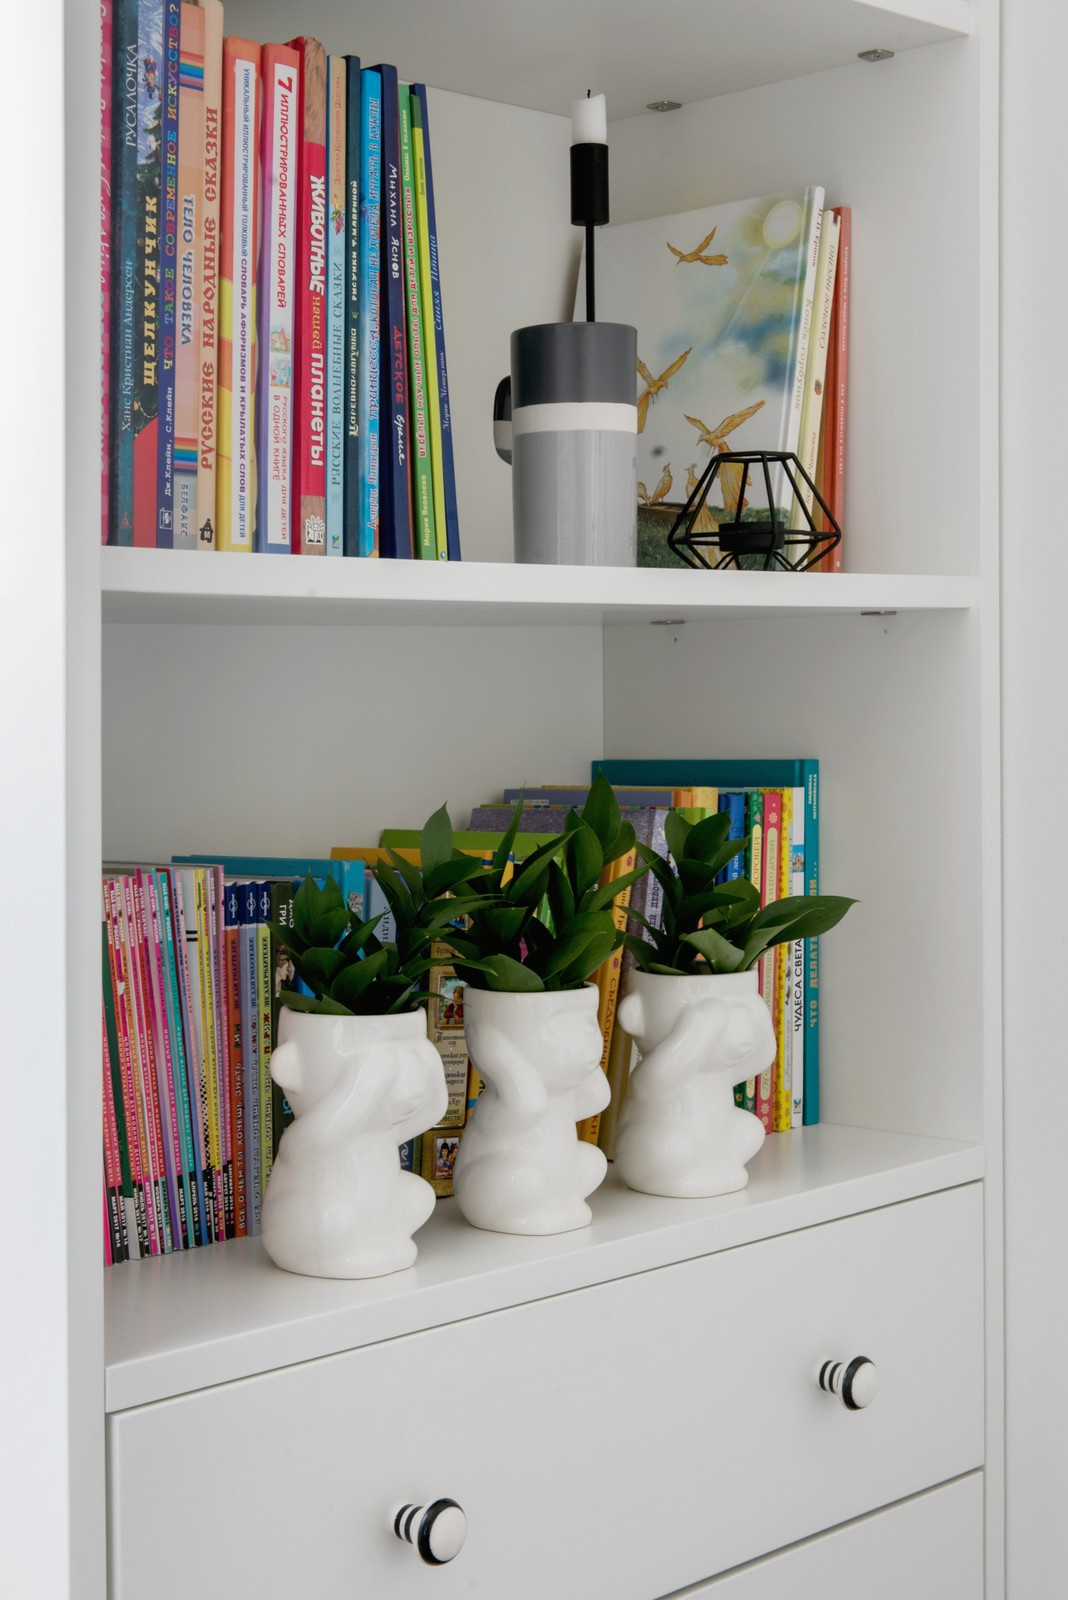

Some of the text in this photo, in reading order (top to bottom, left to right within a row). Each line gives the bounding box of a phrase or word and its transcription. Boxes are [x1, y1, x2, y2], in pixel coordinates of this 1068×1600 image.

[125, 44, 138, 147] РУСАЛОЧКА
[243, 68, 251, 123] УНИКАЛЬНЫЙ
[204, 106, 218, 202] СКАЗКИ
[241, 124, 250, 212] ИЛЛЮСТРИРОВАННЫЙ
[163, 4, 179, 370] ЧТО ТАКОЕ СОВРЕМЕННОЕ ИСКУССТВО?
[277, 76, 293, 308] 7 ИЛЛЮСТРИРОВАННЫХ СЛОВАРЕЙ
[241, 213, 249, 257] ТОЛКОВЫЙ
[309, 174, 326, 296] ЖИВОТНЫЕ
[143, 195, 157, 386] ЩЕЛКУНЧИК
[181, 196, 195, 345] ТЕЛО ЧЕЛОВЕКА
[240, 258, 248, 309] СЛОВАРЬ
[406, 258, 419, 291] ДЕТЕЙ
[409, 294, 420, 314] ДЛЯ
[122, 329, 134, 395] Кристиан
[240, 312, 248, 382] АФОРИЗМОВ
[393, 325, 404, 404] ДЕТСКОЕ
[411, 317, 421, 357] ОПЫТЫ
[331, 262, 343, 485] РУССКИЕ ВОЛШЕБНЫЕ СКАЗКИ
[121, 398, 132, 431] Ханс
[239, 396, 247, 460] КРЫЛАТЫХ
[273, 405, 281, 443] ОДНОЙ
[273, 448, 281, 480] КНИГЕ
[239, 513, 247, 538] ДЕТЕЙ
[794, 938, 803, 1032] ЧУДЕСА СВЕТА
[233, 1024, 241, 1049] РИМ
[263, 1012, 271, 1054] ПАРИЖ
[809, 1000, 818, 1028] ЧТО
[236, 1151, 243, 1167] ТЫ
[237, 1169, 245, 1193] ЧЕМ
